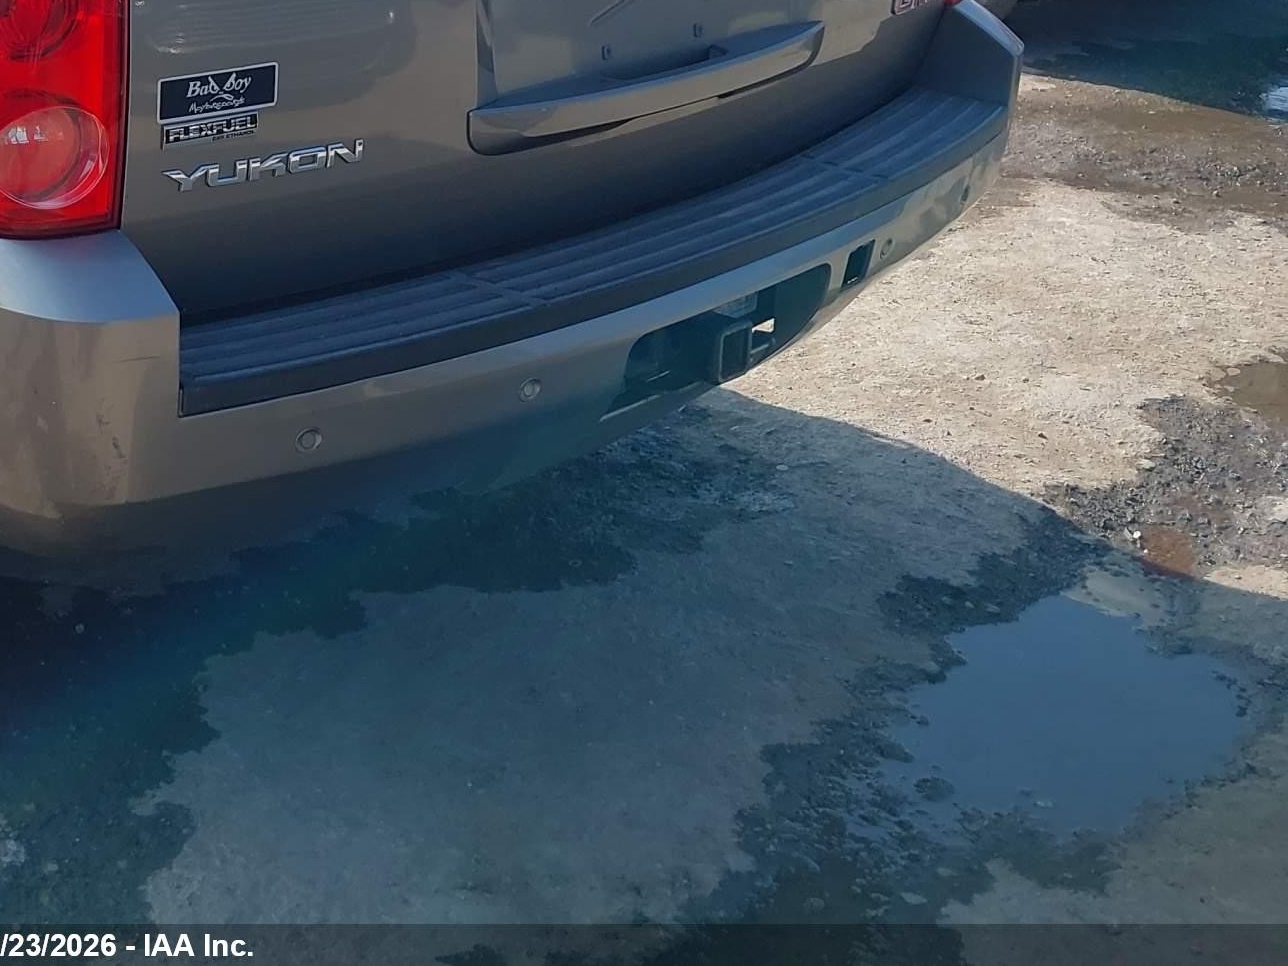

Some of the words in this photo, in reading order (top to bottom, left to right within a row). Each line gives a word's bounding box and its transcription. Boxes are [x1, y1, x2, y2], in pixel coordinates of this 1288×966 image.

[186, 75, 221, 98] Bad
[168, 116, 257, 143] FLEXFUEL
[163, 139, 364, 193] YUKON
